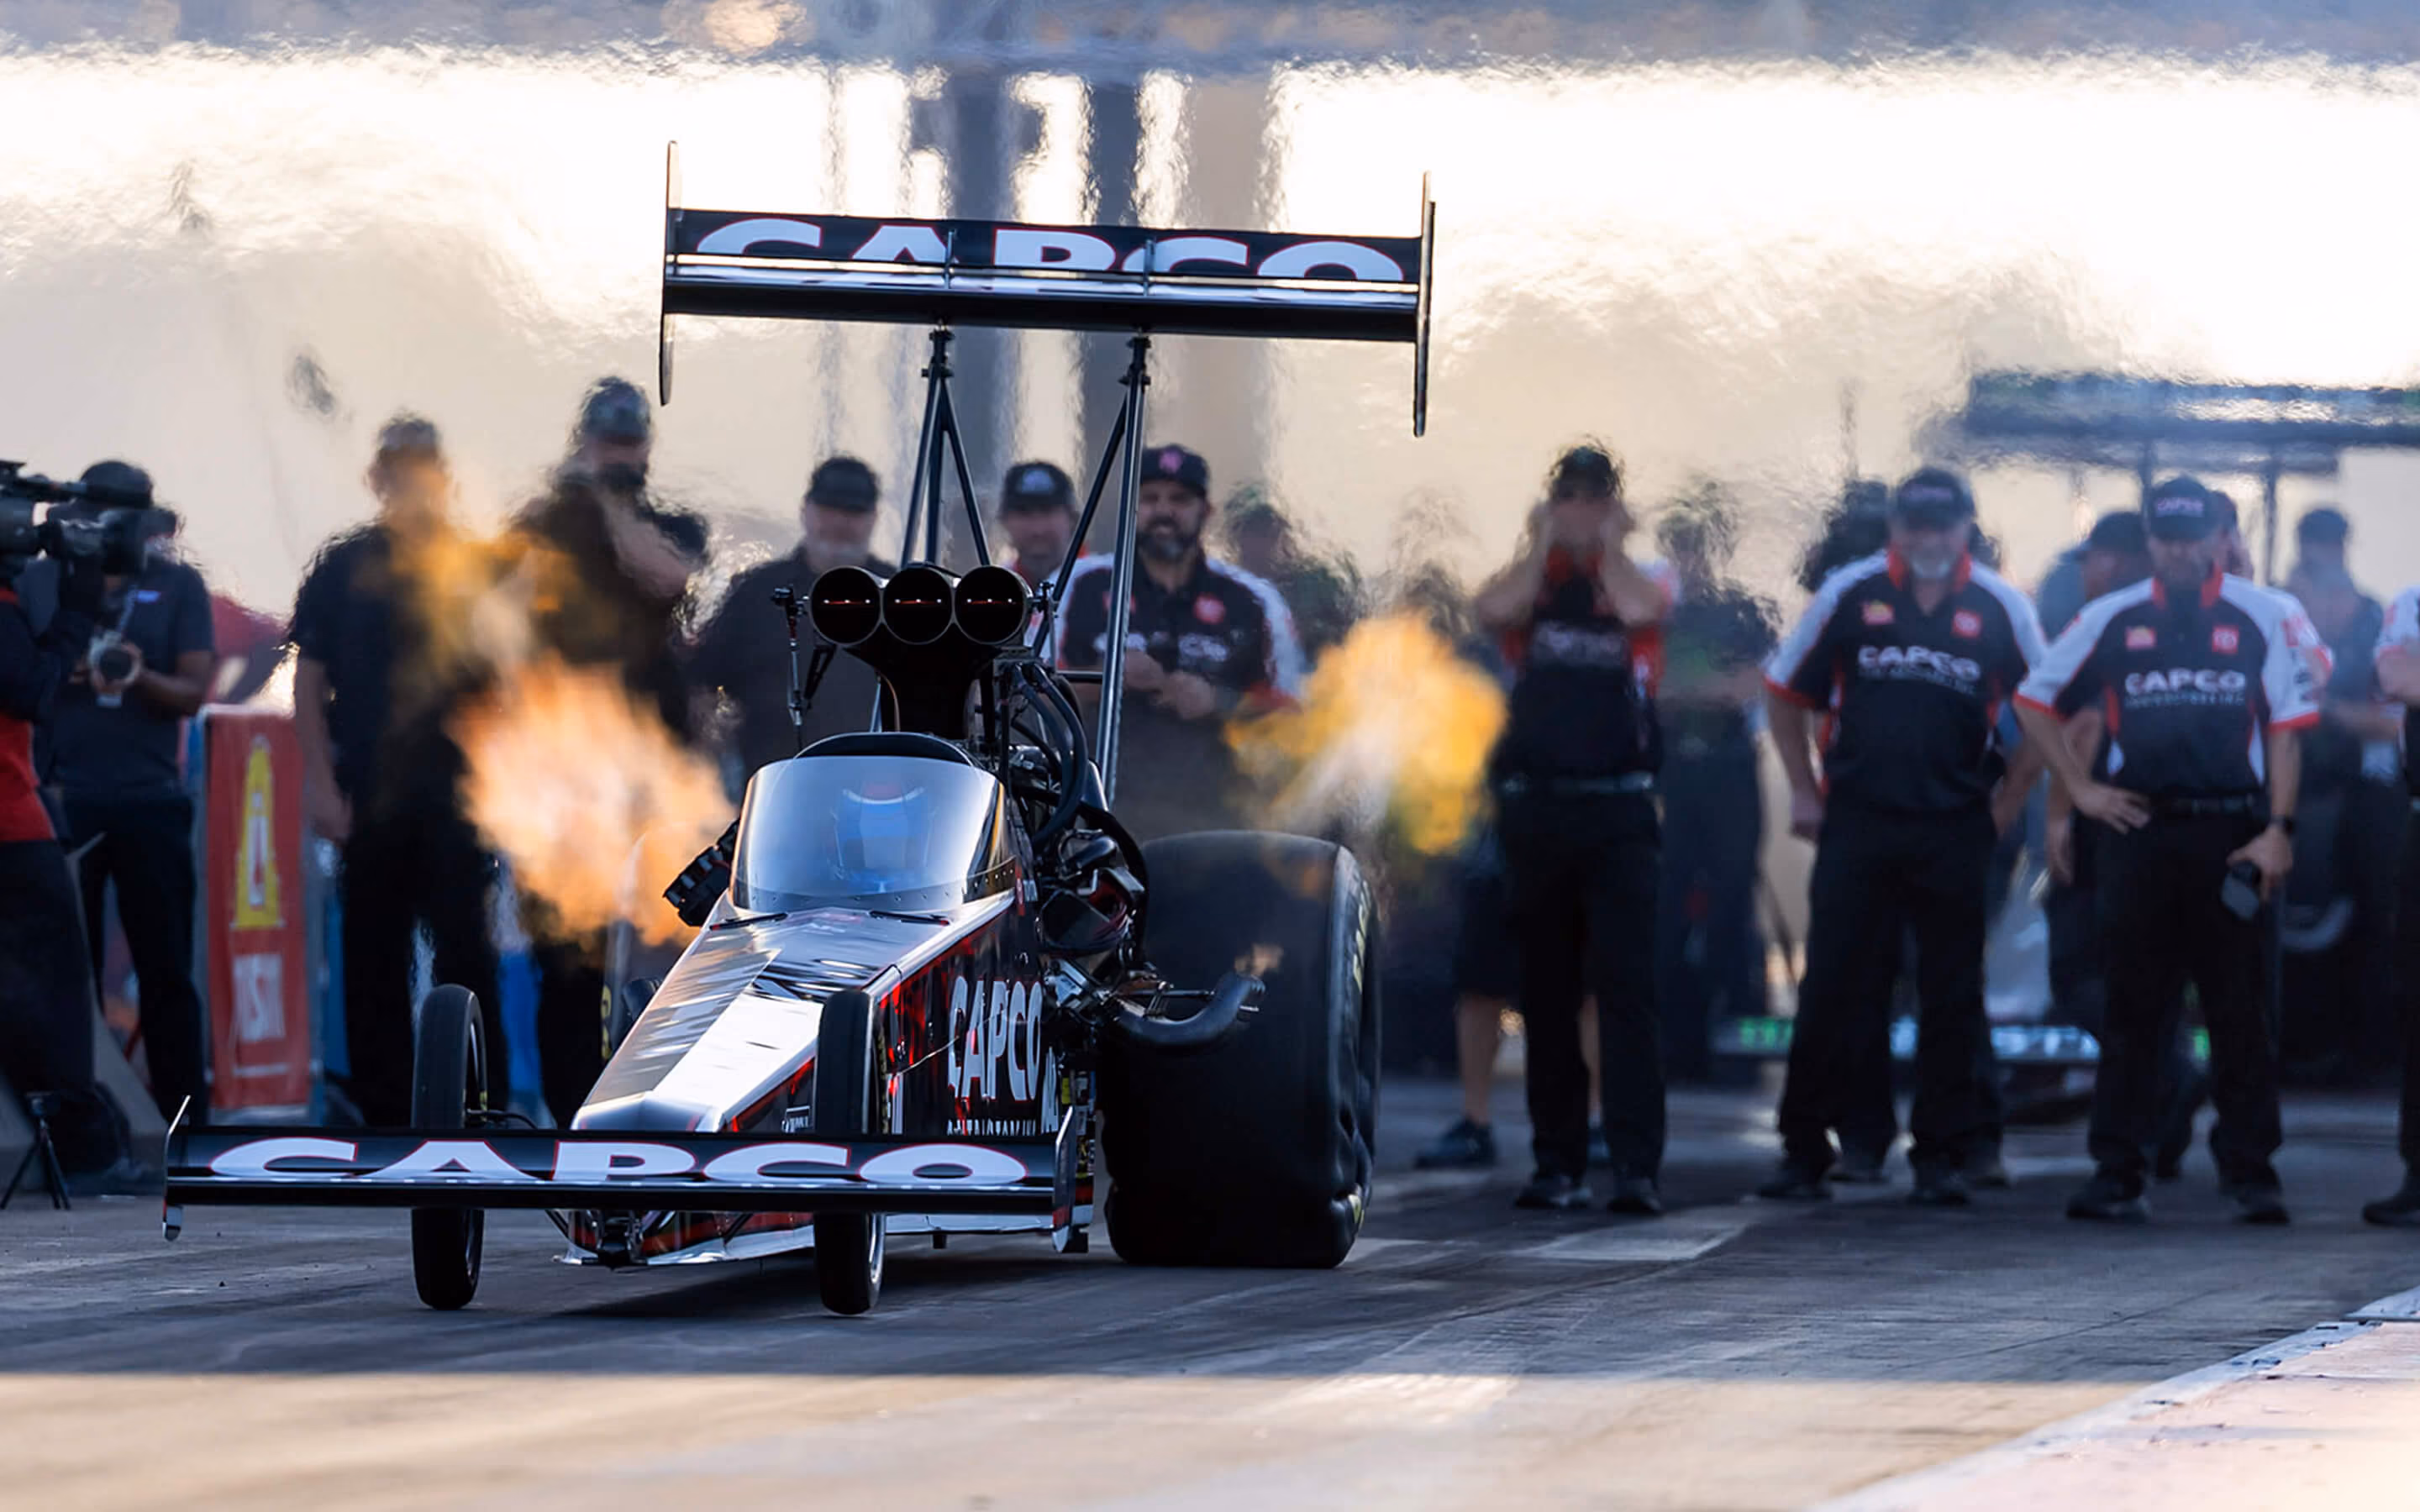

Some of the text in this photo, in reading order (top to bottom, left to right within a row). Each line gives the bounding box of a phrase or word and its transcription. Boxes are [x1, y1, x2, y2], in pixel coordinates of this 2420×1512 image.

[2124, 668, 2246, 696] CAPCO
[948, 975, 1044, 1101] CAPCO
[208, 1137, 1028, 1185] CAPCO
